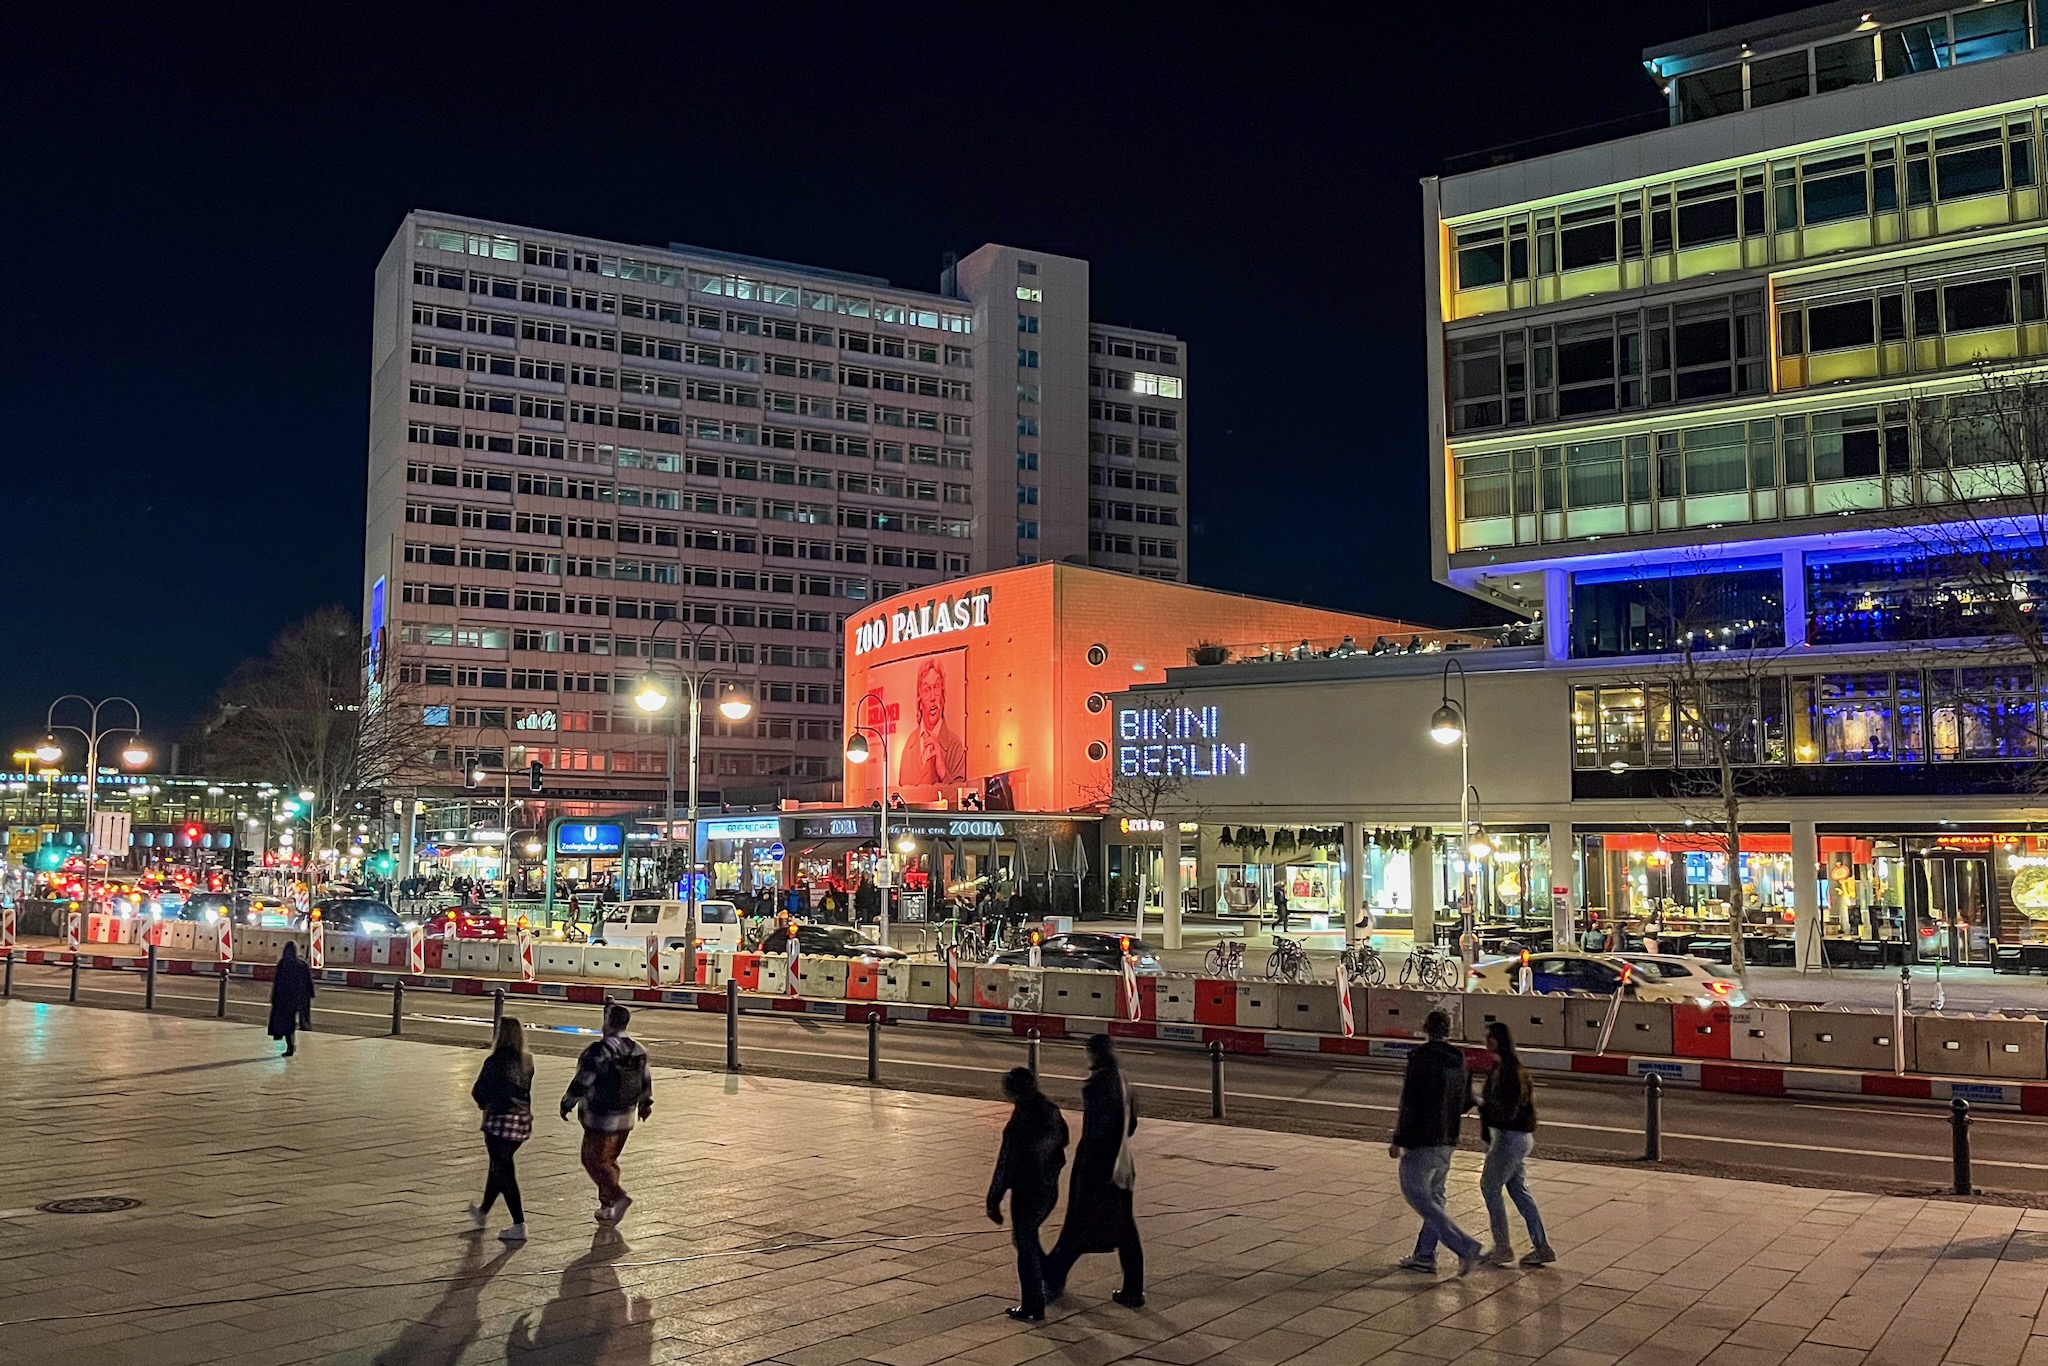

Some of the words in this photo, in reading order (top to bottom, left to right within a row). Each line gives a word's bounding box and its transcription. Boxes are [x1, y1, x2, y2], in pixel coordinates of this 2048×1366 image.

[855, 620, 886, 656] ZOO
[892, 594, 989, 644] PALAST
[1120, 706, 1217, 740] BIKINI
[1120, 742, 1246, 776] BERLIN
[97, 776, 147, 784] GARTEN
[584, 825, 597, 842] U
[949, 821, 1005, 836] ZOOBA
[561, 843, 597, 851] Zoologischer
